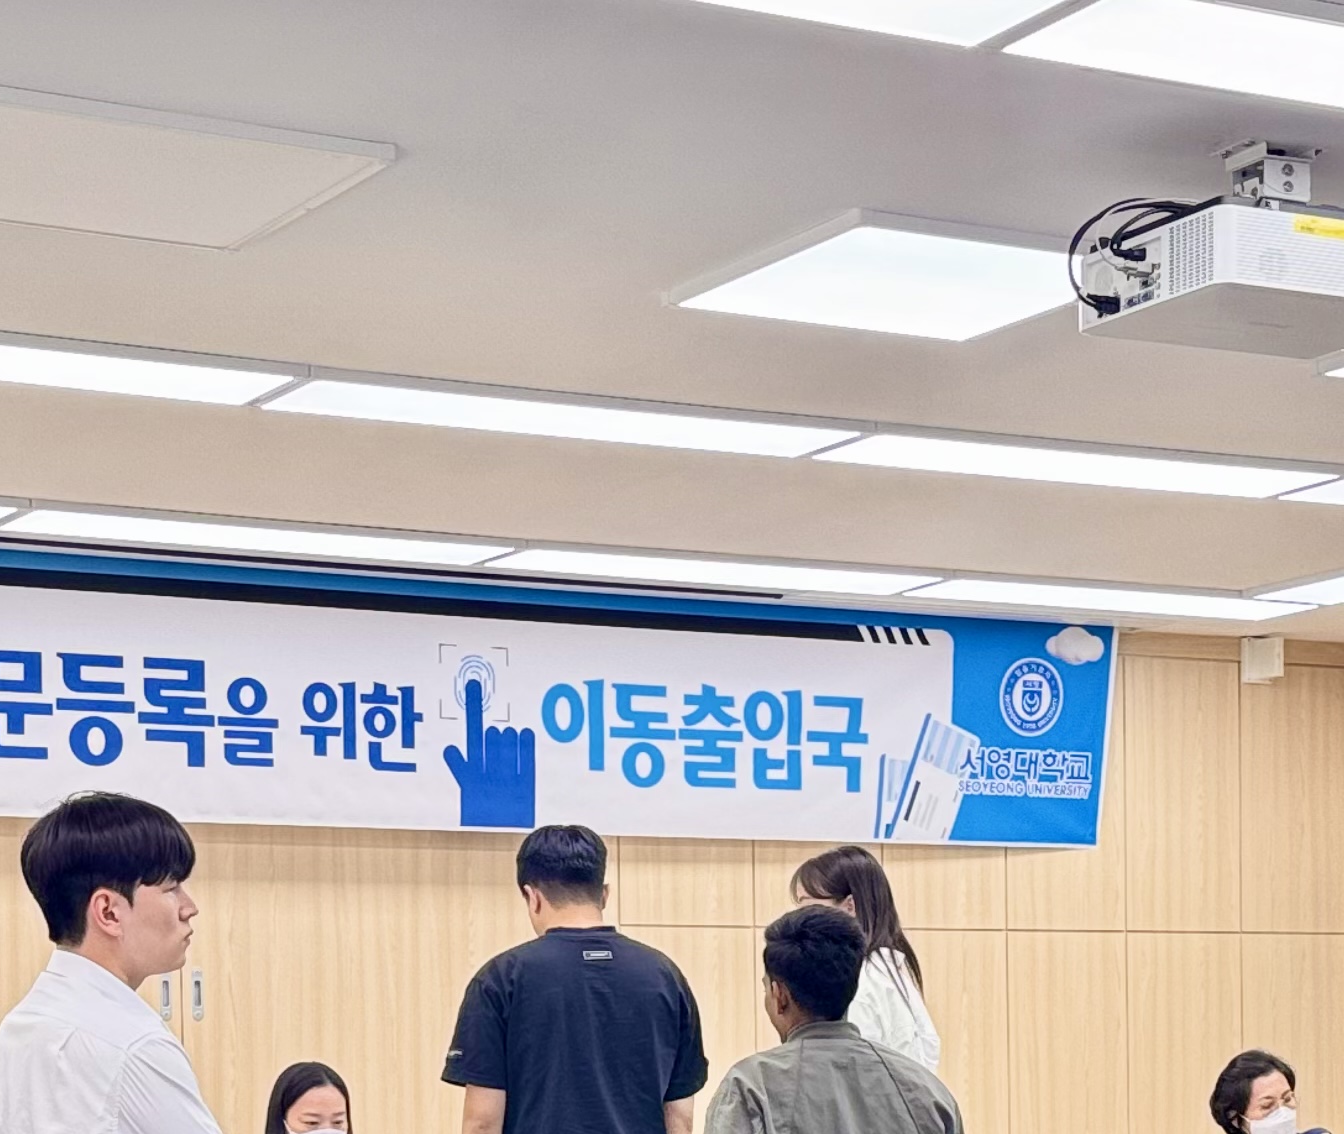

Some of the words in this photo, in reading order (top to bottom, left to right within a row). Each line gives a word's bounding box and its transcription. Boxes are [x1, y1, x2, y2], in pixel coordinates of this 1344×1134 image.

[298, 680, 425, 774] 위한
[539, 677, 871, 795] 이동출입국
[960, 749, 1090, 780] 서영대학교
[958, 780, 1024, 795] SEOYEONG
[1027, 783, 1089, 798] UNIVERSITY
